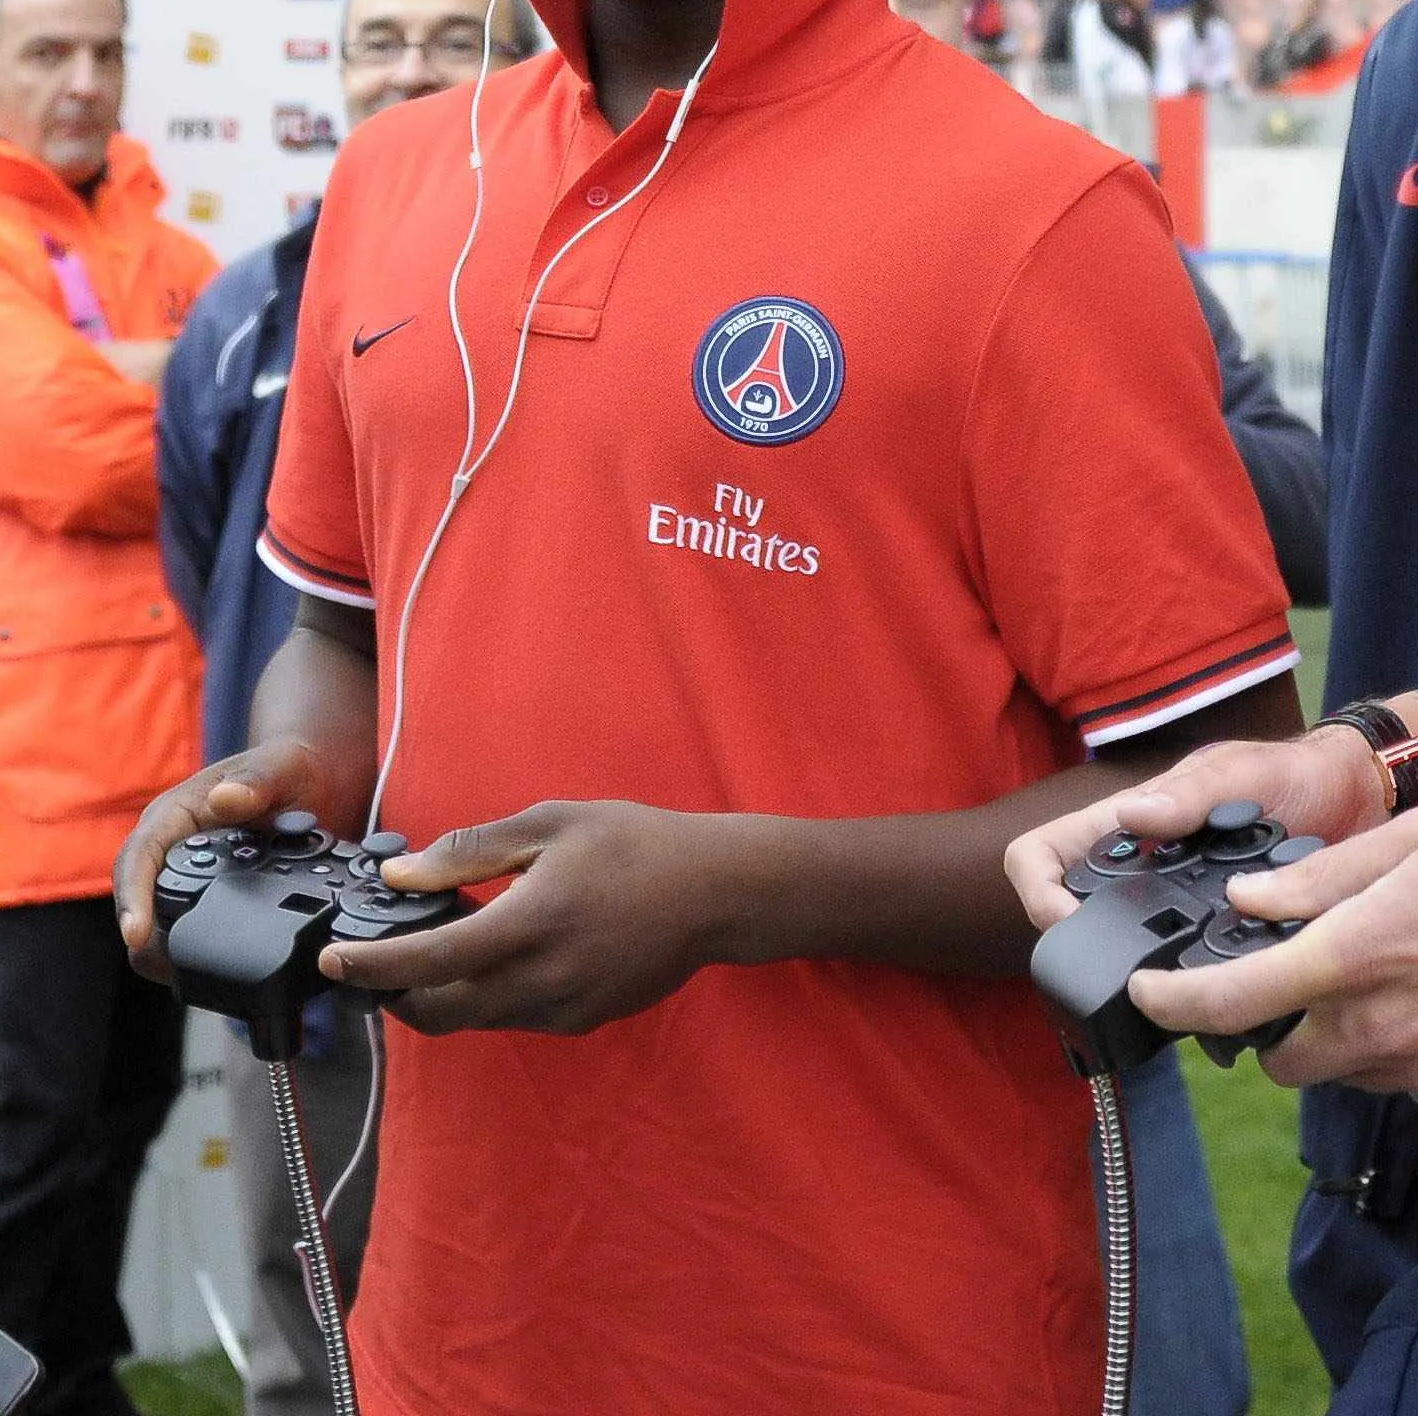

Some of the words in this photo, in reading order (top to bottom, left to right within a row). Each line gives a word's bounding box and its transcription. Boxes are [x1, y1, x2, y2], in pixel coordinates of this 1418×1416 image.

[725, 312, 758, 338] PARIS
[739, 417, 769, 433] 1970
[713, 483, 765, 527] Fly
[647, 503, 821, 576] Emirates
